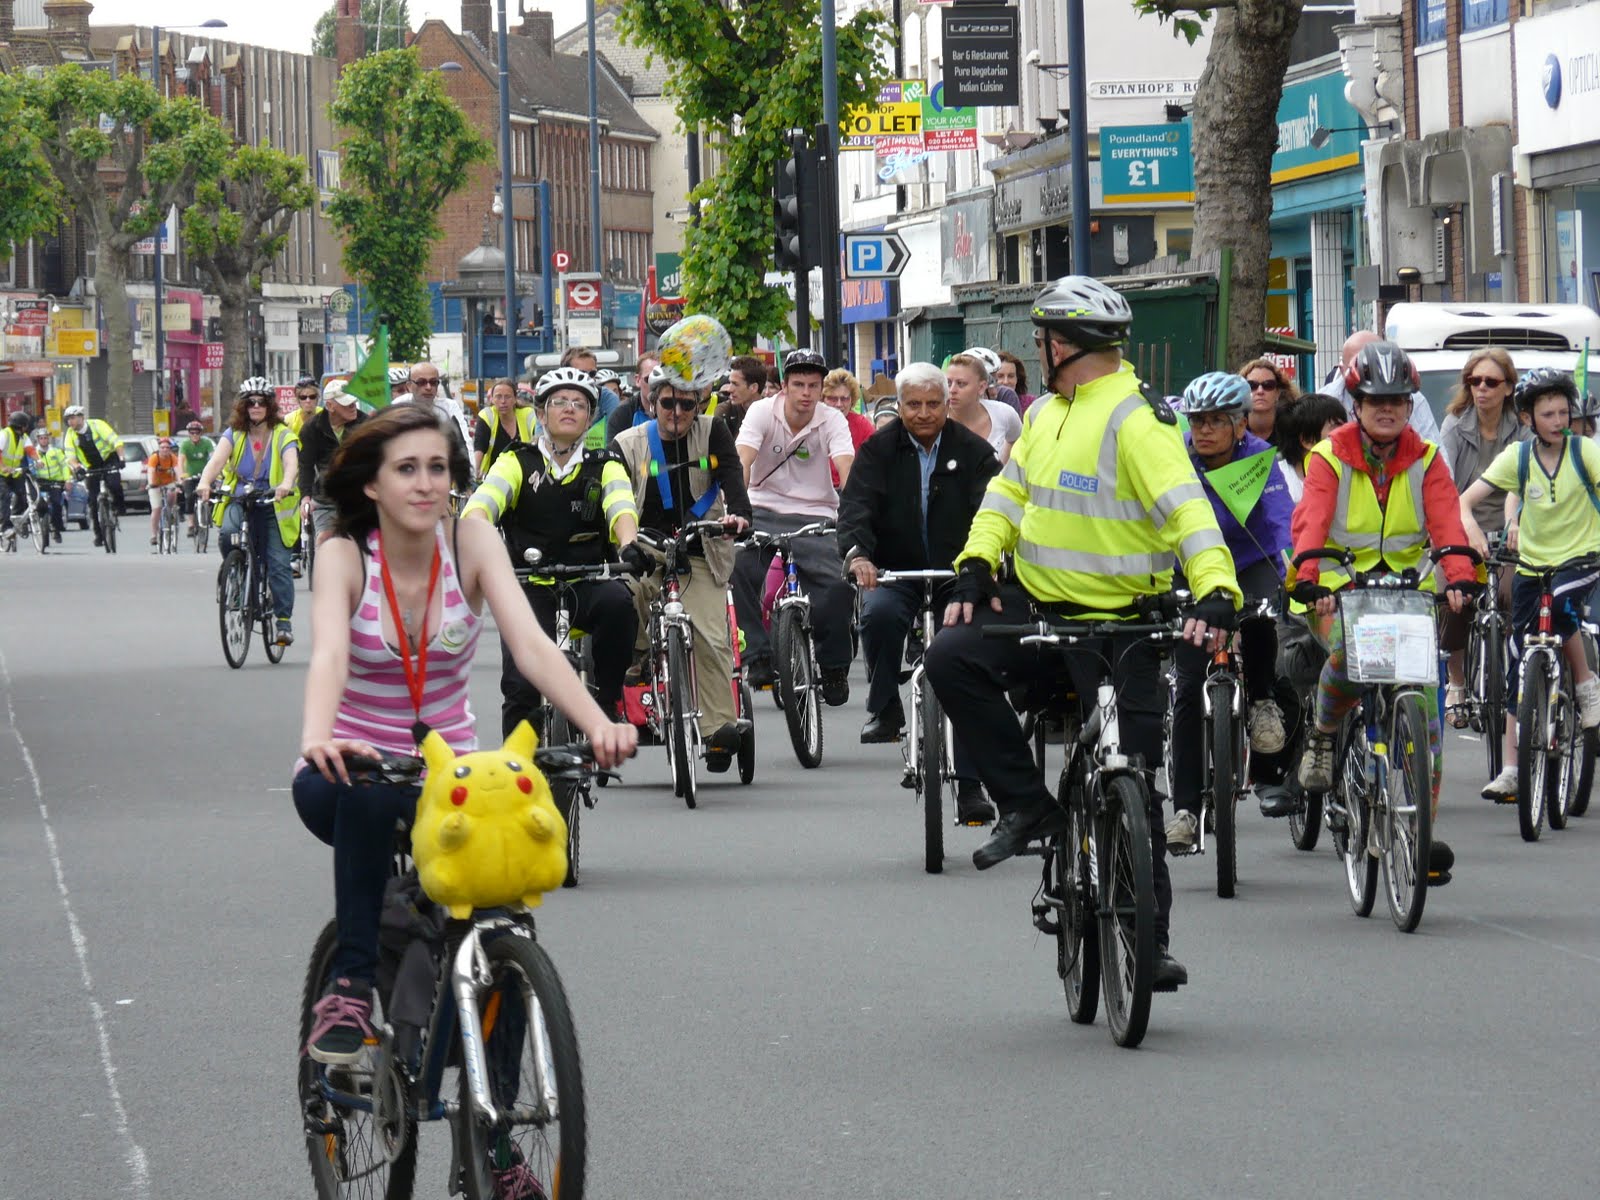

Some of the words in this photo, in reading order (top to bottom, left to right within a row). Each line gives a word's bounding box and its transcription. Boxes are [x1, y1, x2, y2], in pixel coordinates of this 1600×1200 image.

[952, 50, 964, 60] Bar
[965, 50, 971, 60] &
[971, 50, 1009, 60] Restaurant
[954, 66, 970, 76] Pure
[971, 64, 1008, 78] Vegetarian
[1569, 53, 1600, 95] OPTICIA
[959, 80, 979, 92] Indian
[980, 80, 1003, 92] Cuisine
[1099, 83, 1174, 95] STANHOPE
[1183, 83, 1199, 92] RO
[880, 115, 922, 132] LET
[926, 117, 947, 126] YOUR
[949, 116, 972, 125] MOVE
[1109, 133, 1165, 144] Poundland
[1111, 147, 1178, 159] EVERYTHING'S
[1128, 159, 1160, 186] £1
[557, 253, 568, 266] D
[858, 245, 876, 268] P
[1044, 308, 1066, 316] POLICE
[1061, 471, 1096, 491] POLICE
[1235, 478, 1256, 495] Bicycle
